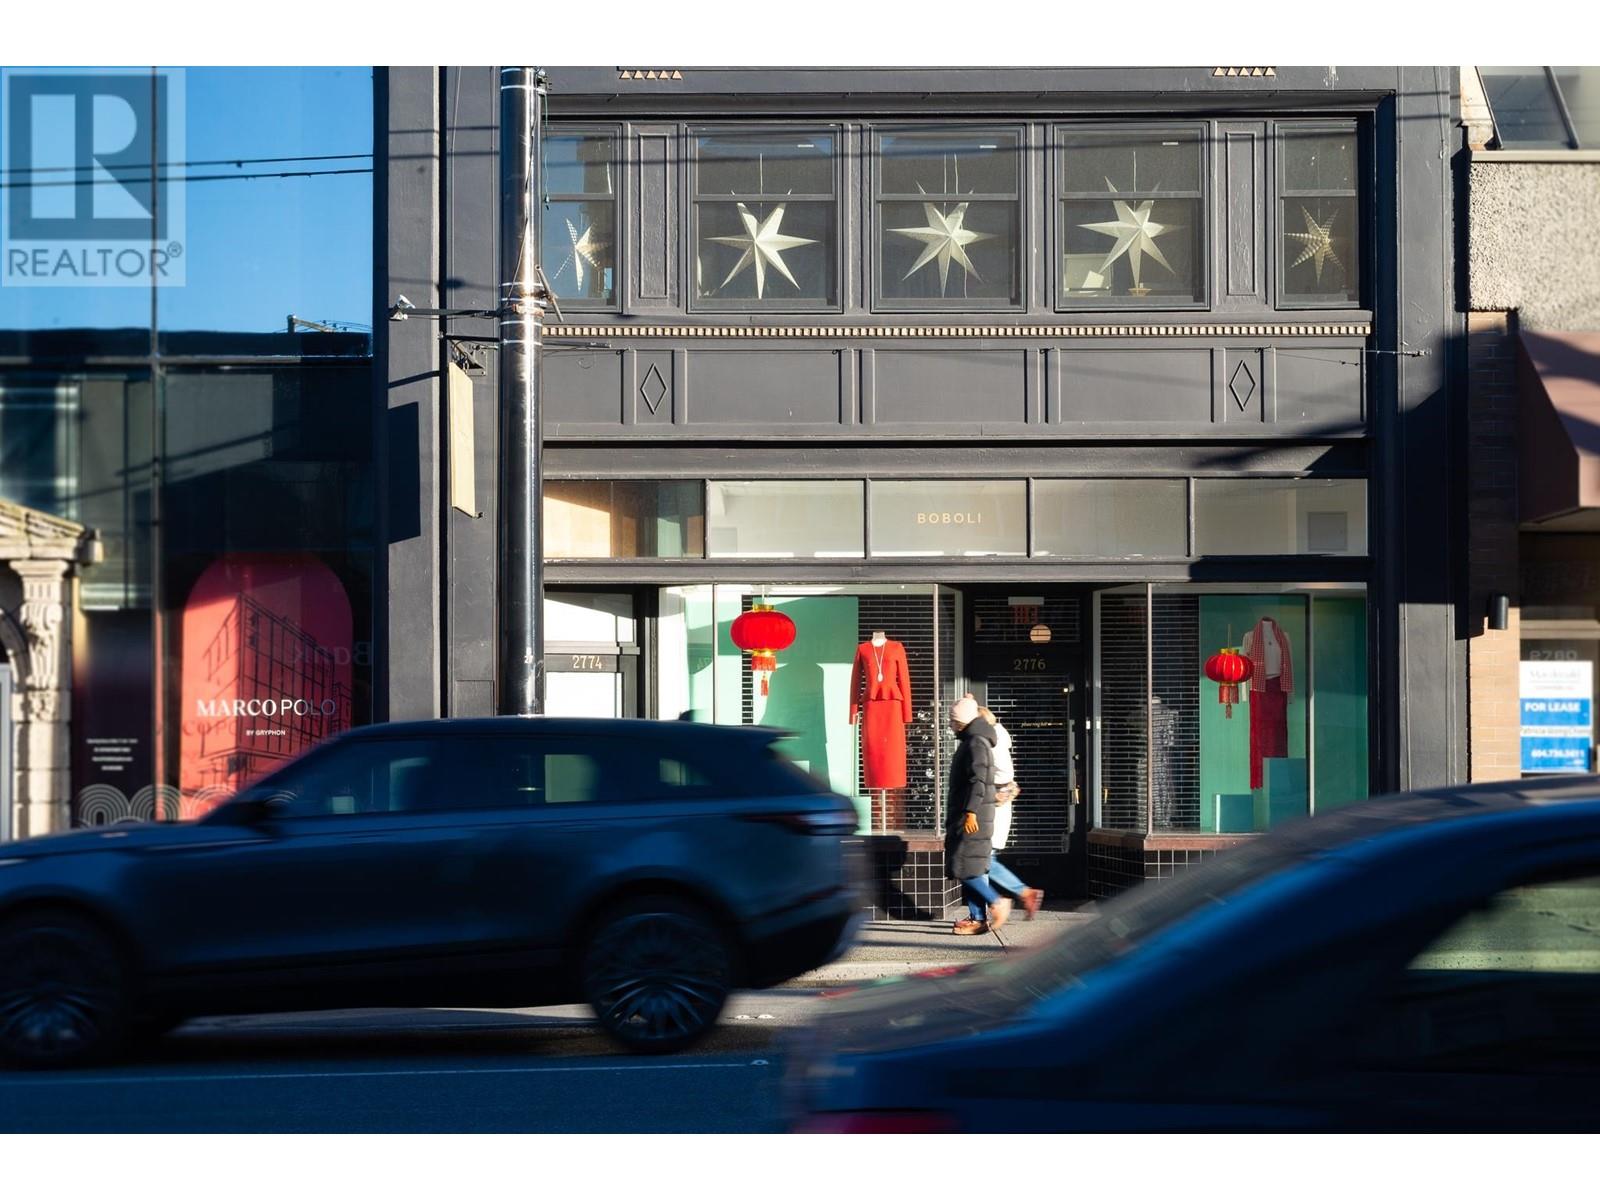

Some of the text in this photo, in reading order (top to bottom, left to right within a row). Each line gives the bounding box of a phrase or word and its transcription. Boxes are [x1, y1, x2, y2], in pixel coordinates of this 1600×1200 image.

[917, 512, 982, 524] BOBOLI
[572, 655, 602, 669] 2774
[1013, 659, 1046, 671] 2776
[196, 698, 277, 717] MARCO
[1525, 702, 1581, 713] FOR LEASE
